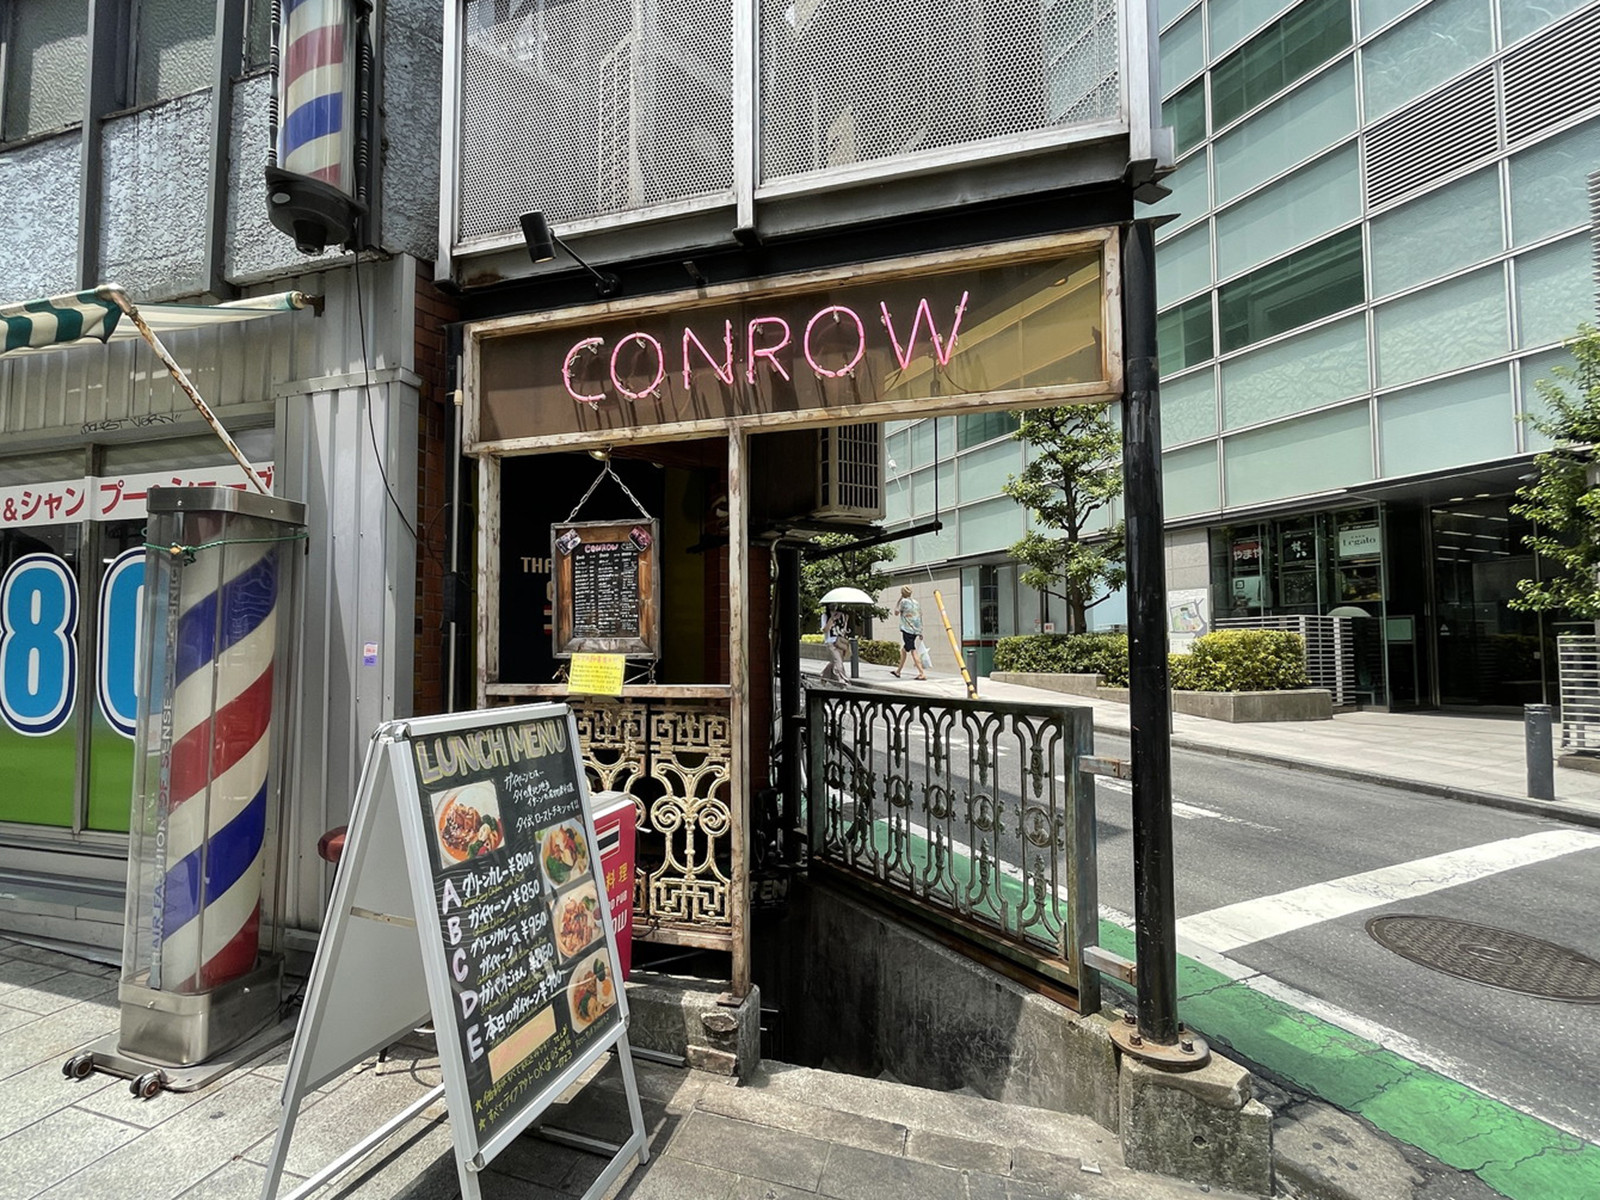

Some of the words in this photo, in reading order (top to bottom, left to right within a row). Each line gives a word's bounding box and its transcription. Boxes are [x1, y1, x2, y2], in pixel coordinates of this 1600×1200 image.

[562, 291, 969, 402] CONROW
[416, 729, 509, 784] LUNCH
[508, 720, 567, 763] MENU
[443, 878, 462, 915] A
[508, 852, 534, 877] ¥800
[447, 916, 462, 945] B
[512, 879, 540, 907] ¥850
[453, 948, 468, 982] C
[521, 911, 548, 939] ¥950
[460, 990, 478, 1019] D
[467, 1024, 485, 1063] E
